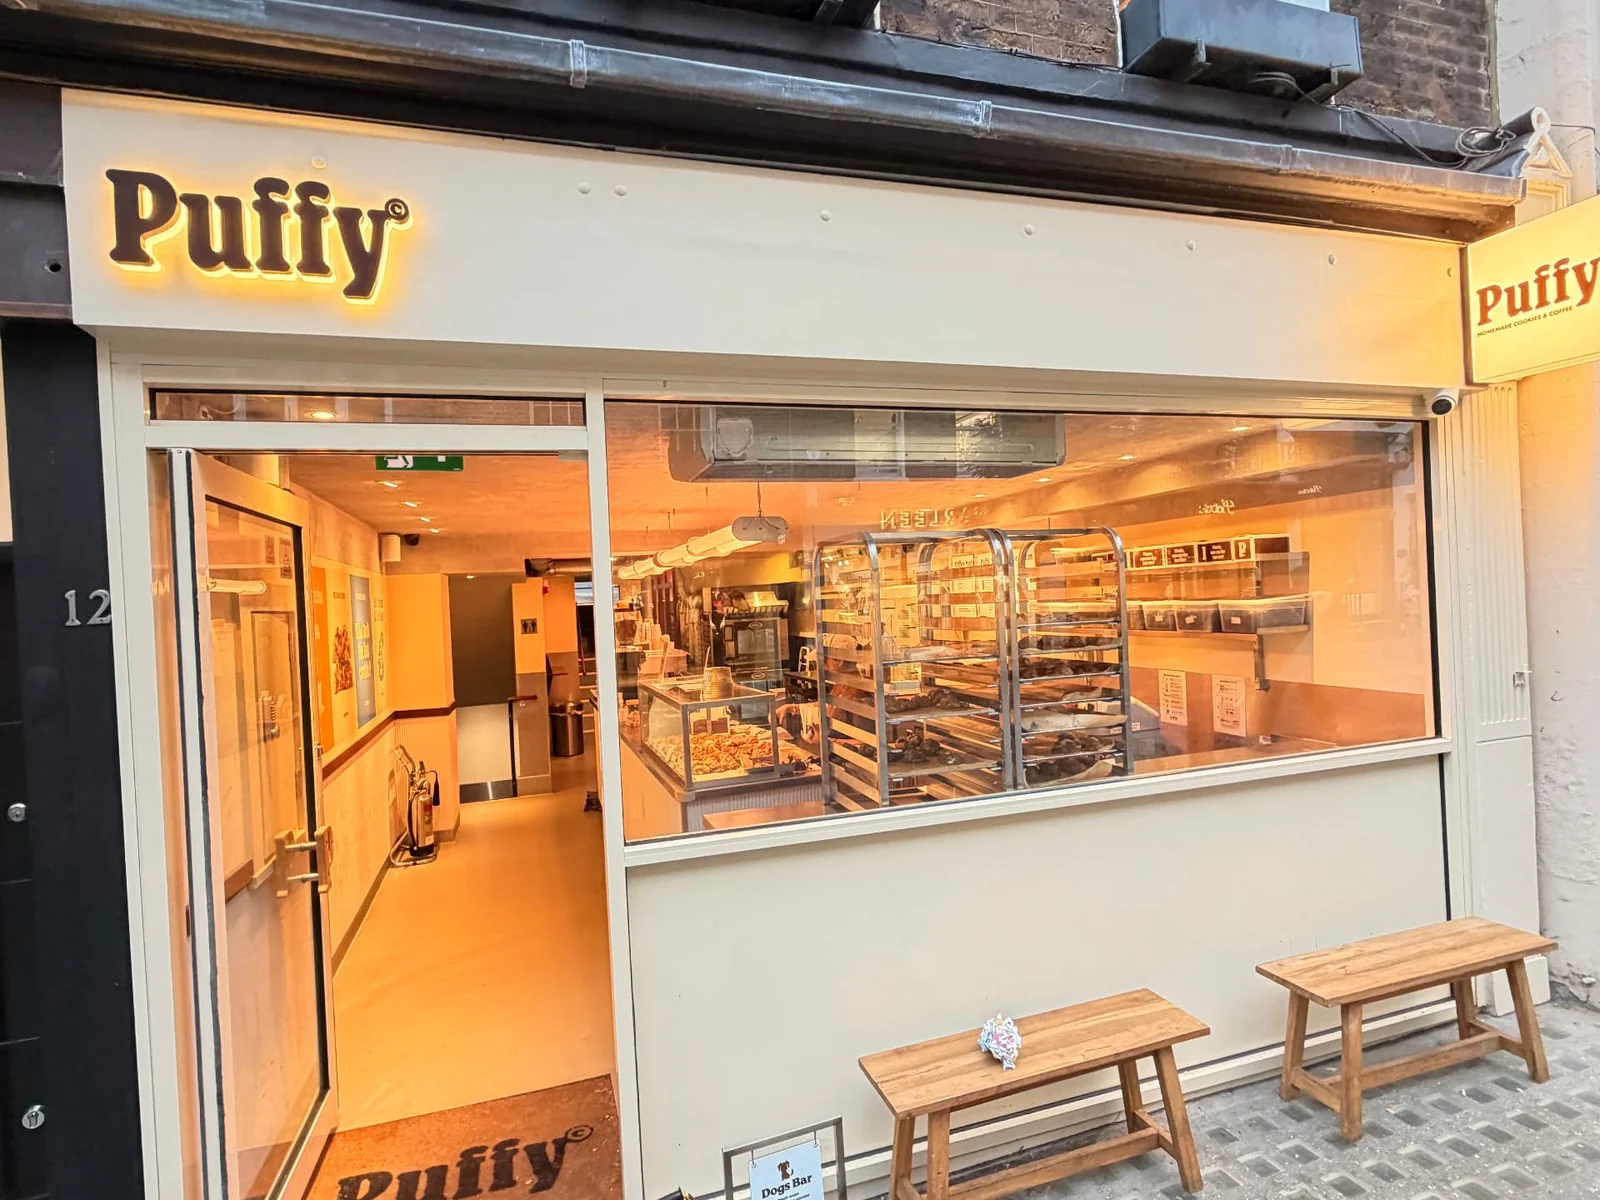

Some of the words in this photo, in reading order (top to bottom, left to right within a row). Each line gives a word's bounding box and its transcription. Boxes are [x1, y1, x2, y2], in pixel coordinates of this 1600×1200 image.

[1476, 257, 1600, 326] Puffy
[1477, 323, 1512, 337] HOMEMADE
[1513, 314, 1541, 327] COOKIES
[1549, 305, 1573, 317] COFFEE
[64, 588, 112, 627] 12
[761, 1181, 791, 1199] Dogs
[792, 1173, 813, 1189] Bar
